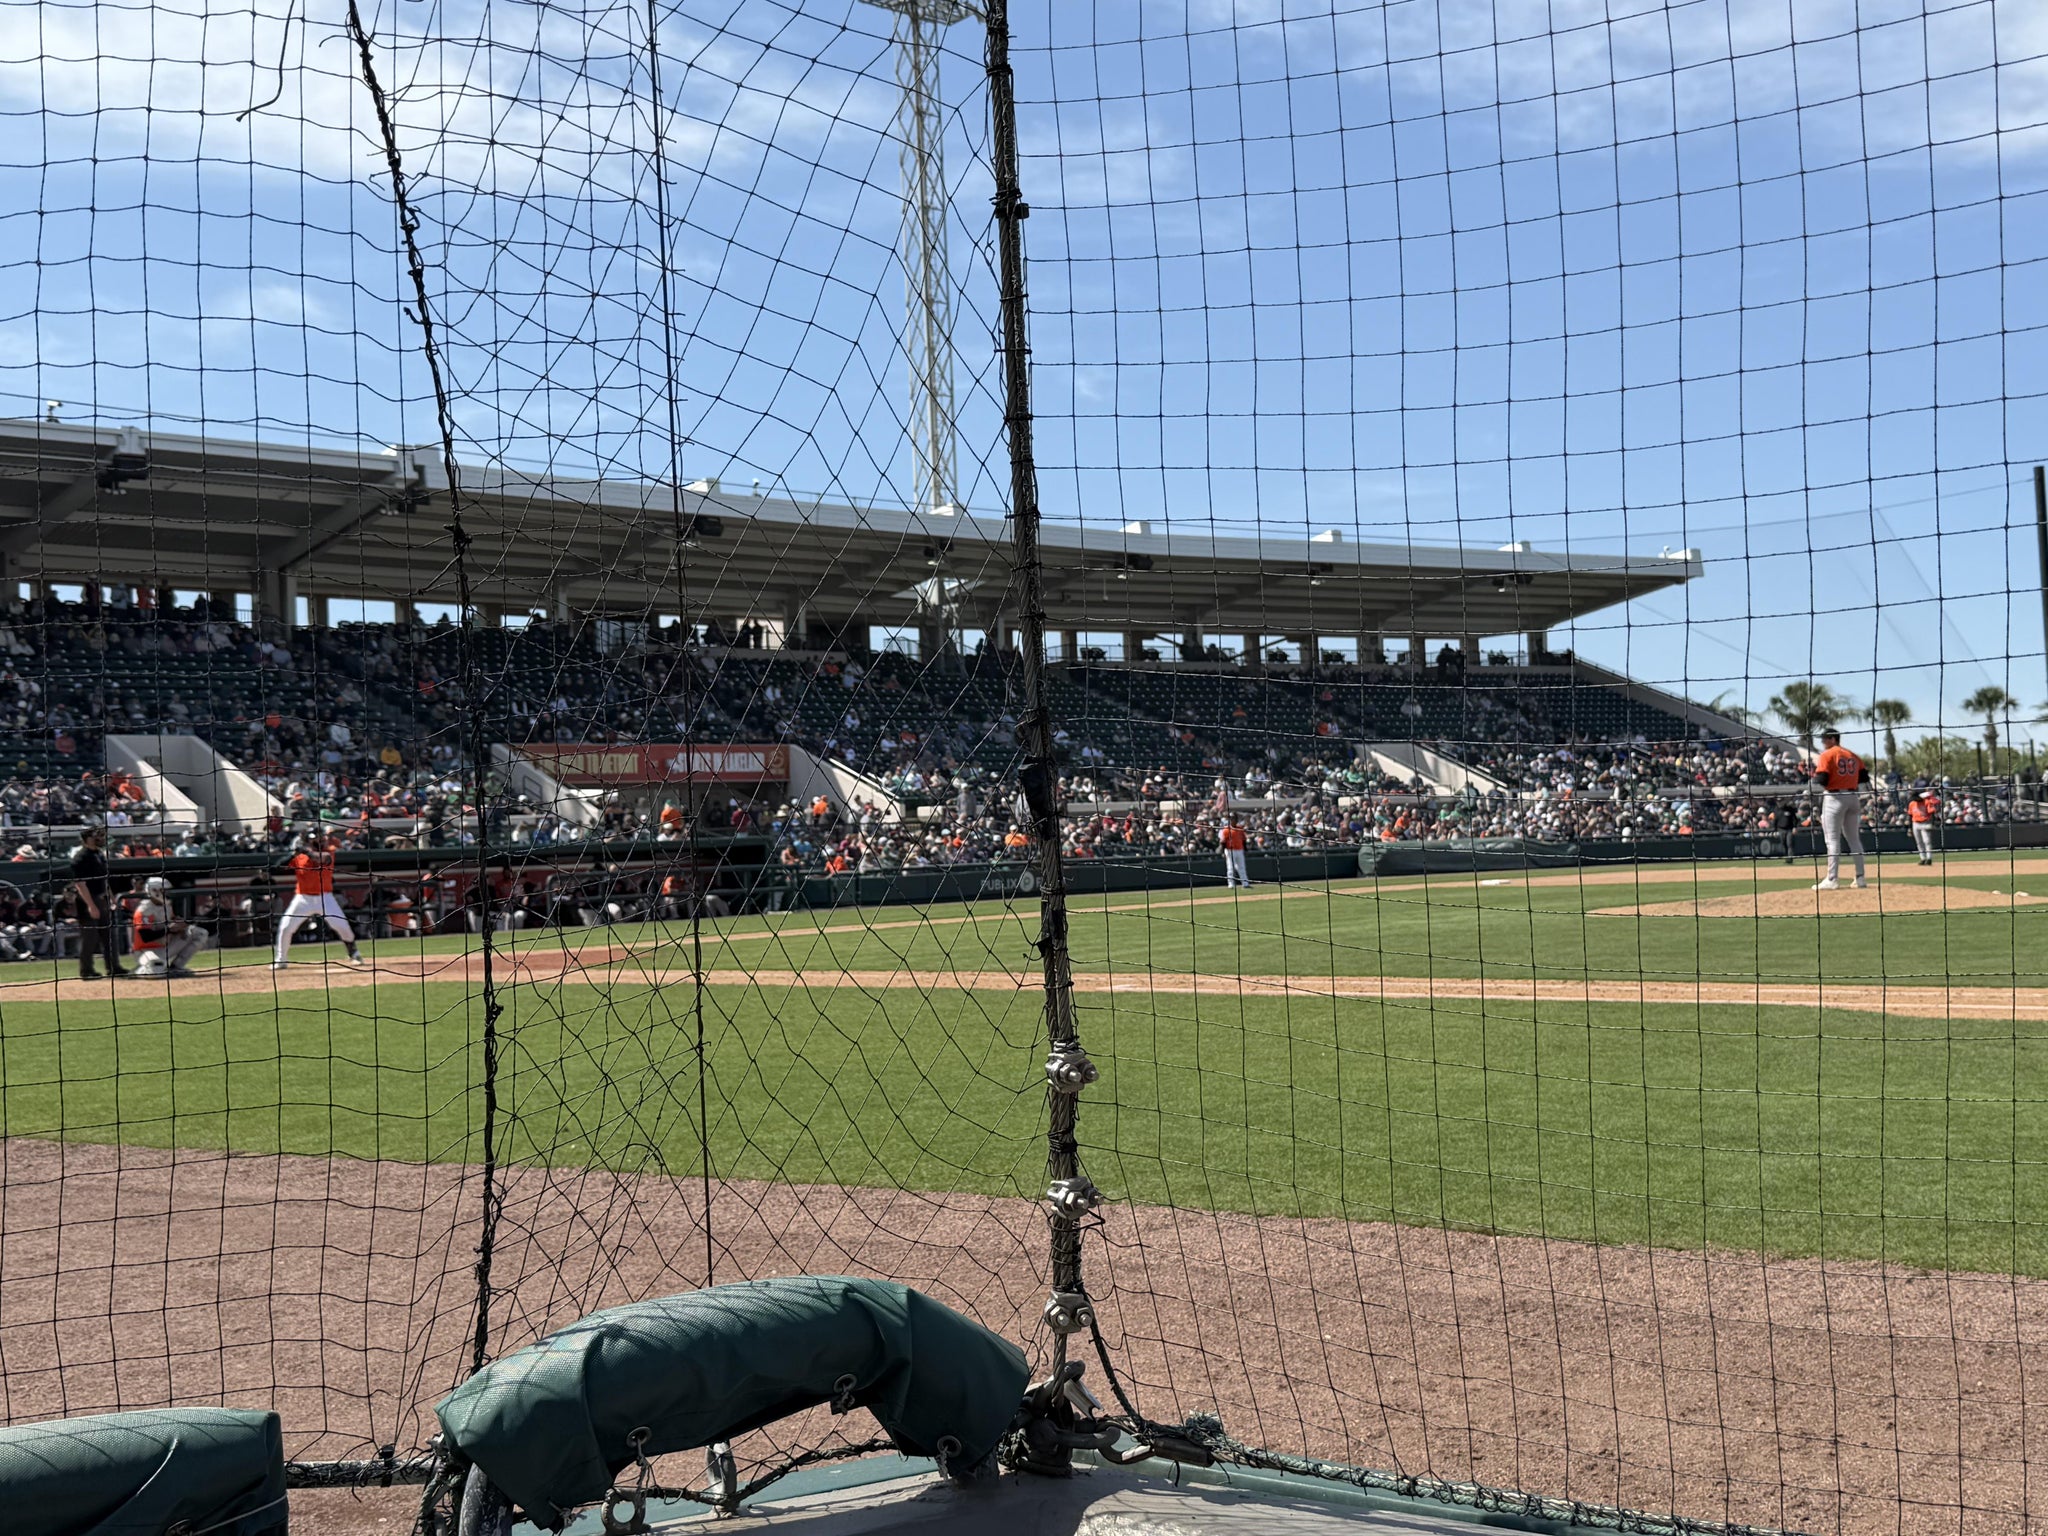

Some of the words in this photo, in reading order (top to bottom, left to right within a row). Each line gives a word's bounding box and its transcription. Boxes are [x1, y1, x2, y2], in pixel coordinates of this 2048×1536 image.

[1837, 757, 1856, 776] 93
[1734, 845, 1761, 855] PUBLX
[980, 877, 1017, 891] PUBLIX
